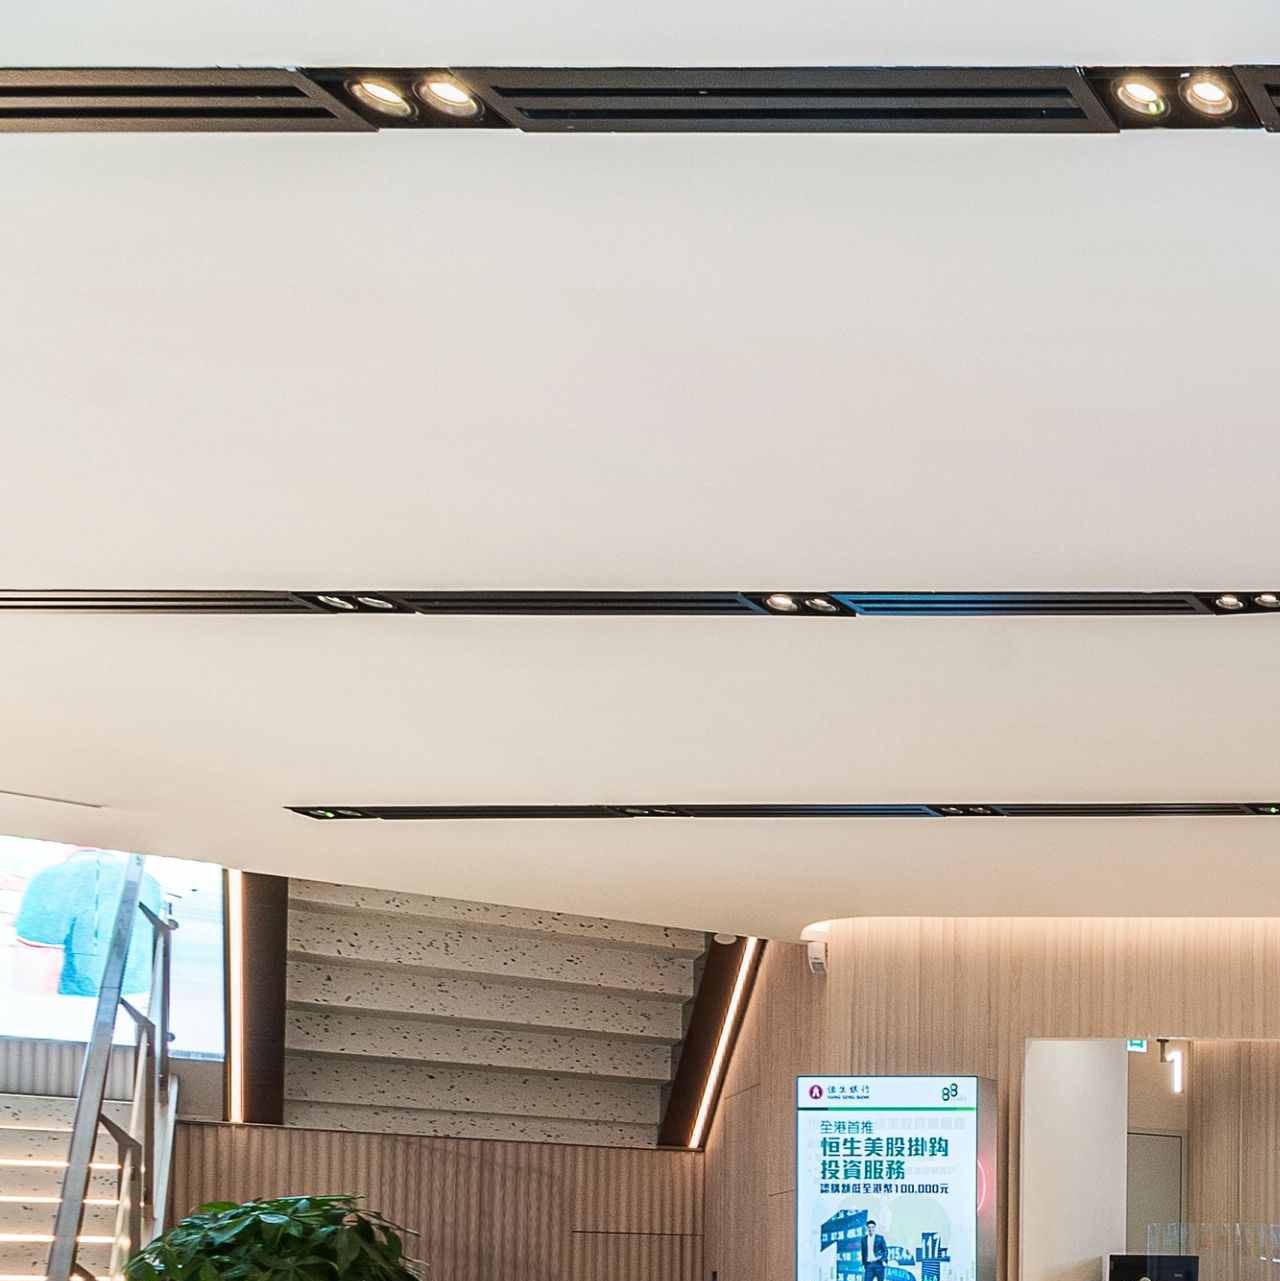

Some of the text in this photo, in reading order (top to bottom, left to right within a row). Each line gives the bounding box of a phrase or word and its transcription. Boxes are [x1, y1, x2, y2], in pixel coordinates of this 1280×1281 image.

[1167, 1051, 1182, 1093] 1
[820, 1120, 874, 1134] 全港首推
[820, 1159, 905, 1180] 投資服務
